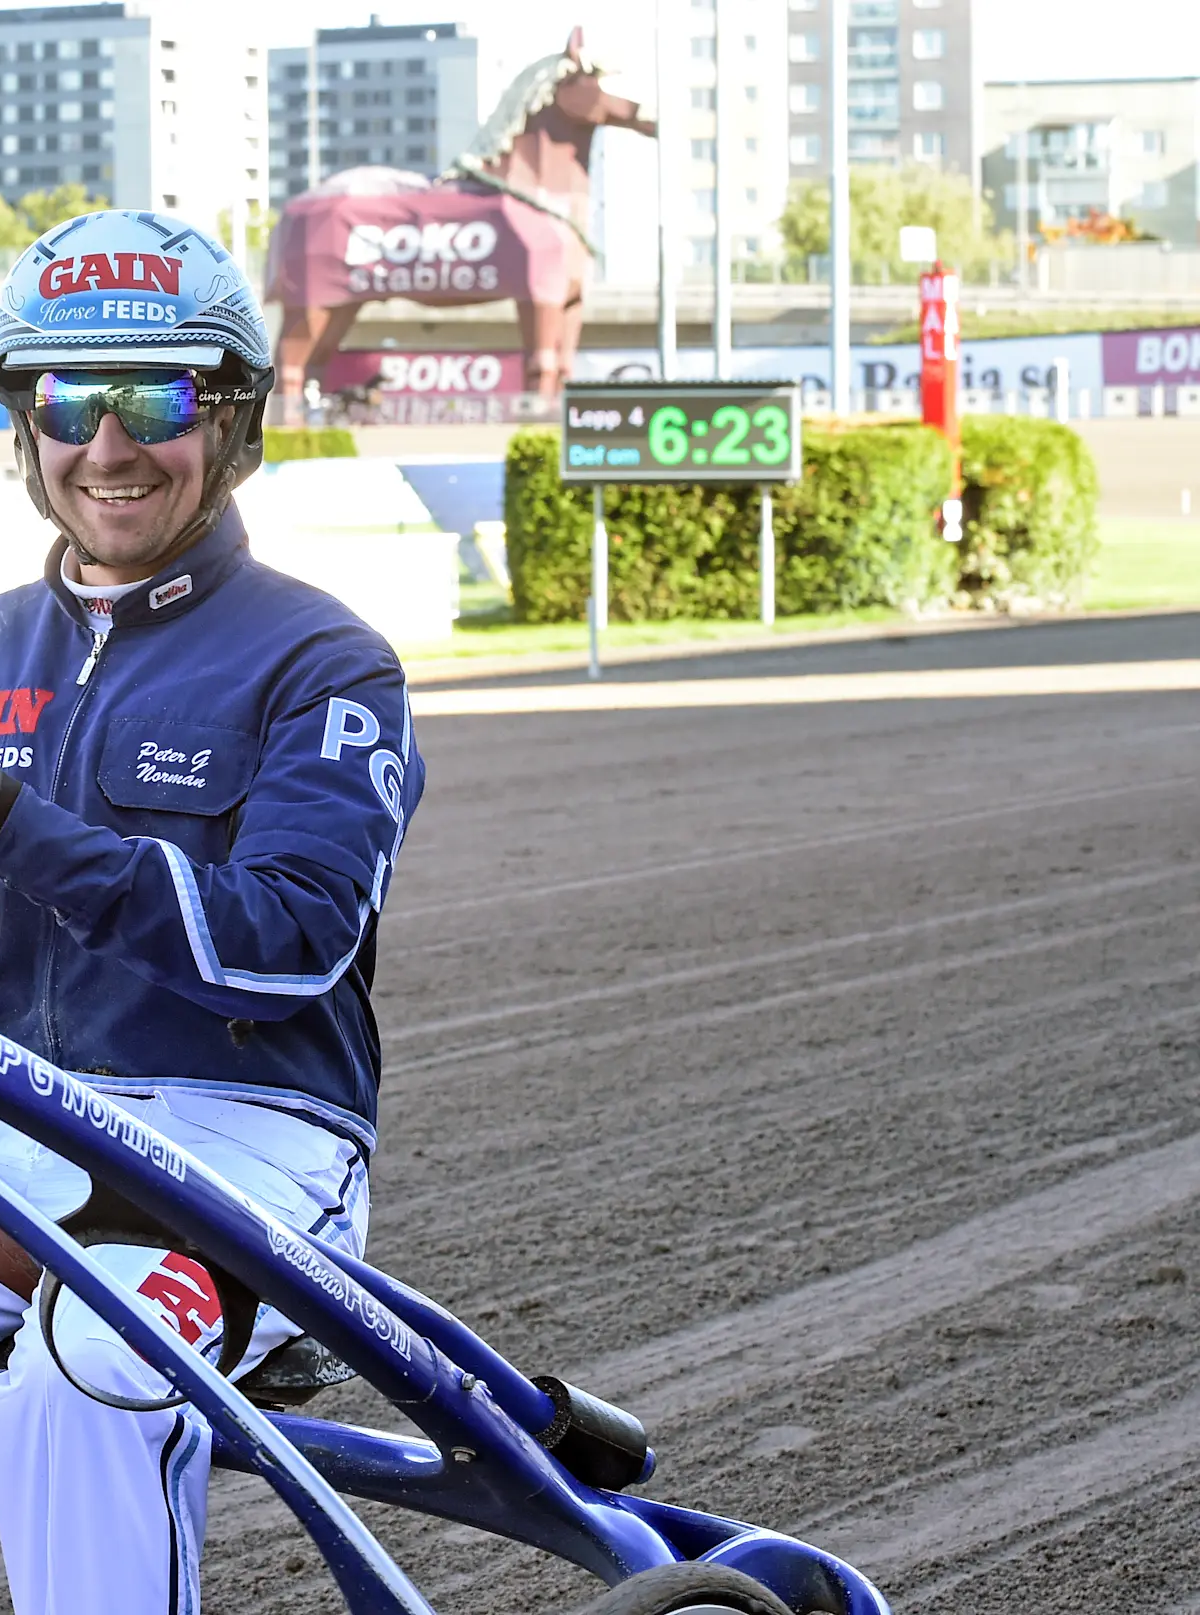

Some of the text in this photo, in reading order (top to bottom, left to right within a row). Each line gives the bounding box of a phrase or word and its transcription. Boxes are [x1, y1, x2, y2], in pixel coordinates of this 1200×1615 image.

[344, 221, 498, 265] BOKO
[39, 253, 182, 299] GAIN
[349, 262, 498, 293] stables
[37, 297, 177, 325] Horse FEEDS
[380, 355, 502, 392] BOKO
[628, 406, 644, 427] 4
[649, 406, 791, 465] 6:23
[139, 741, 213, 772] Peter G
[136, 763, 207, 788] Norman
[27, 1054, 55, 1097] G
[61, 1078, 187, 1183] Norman
